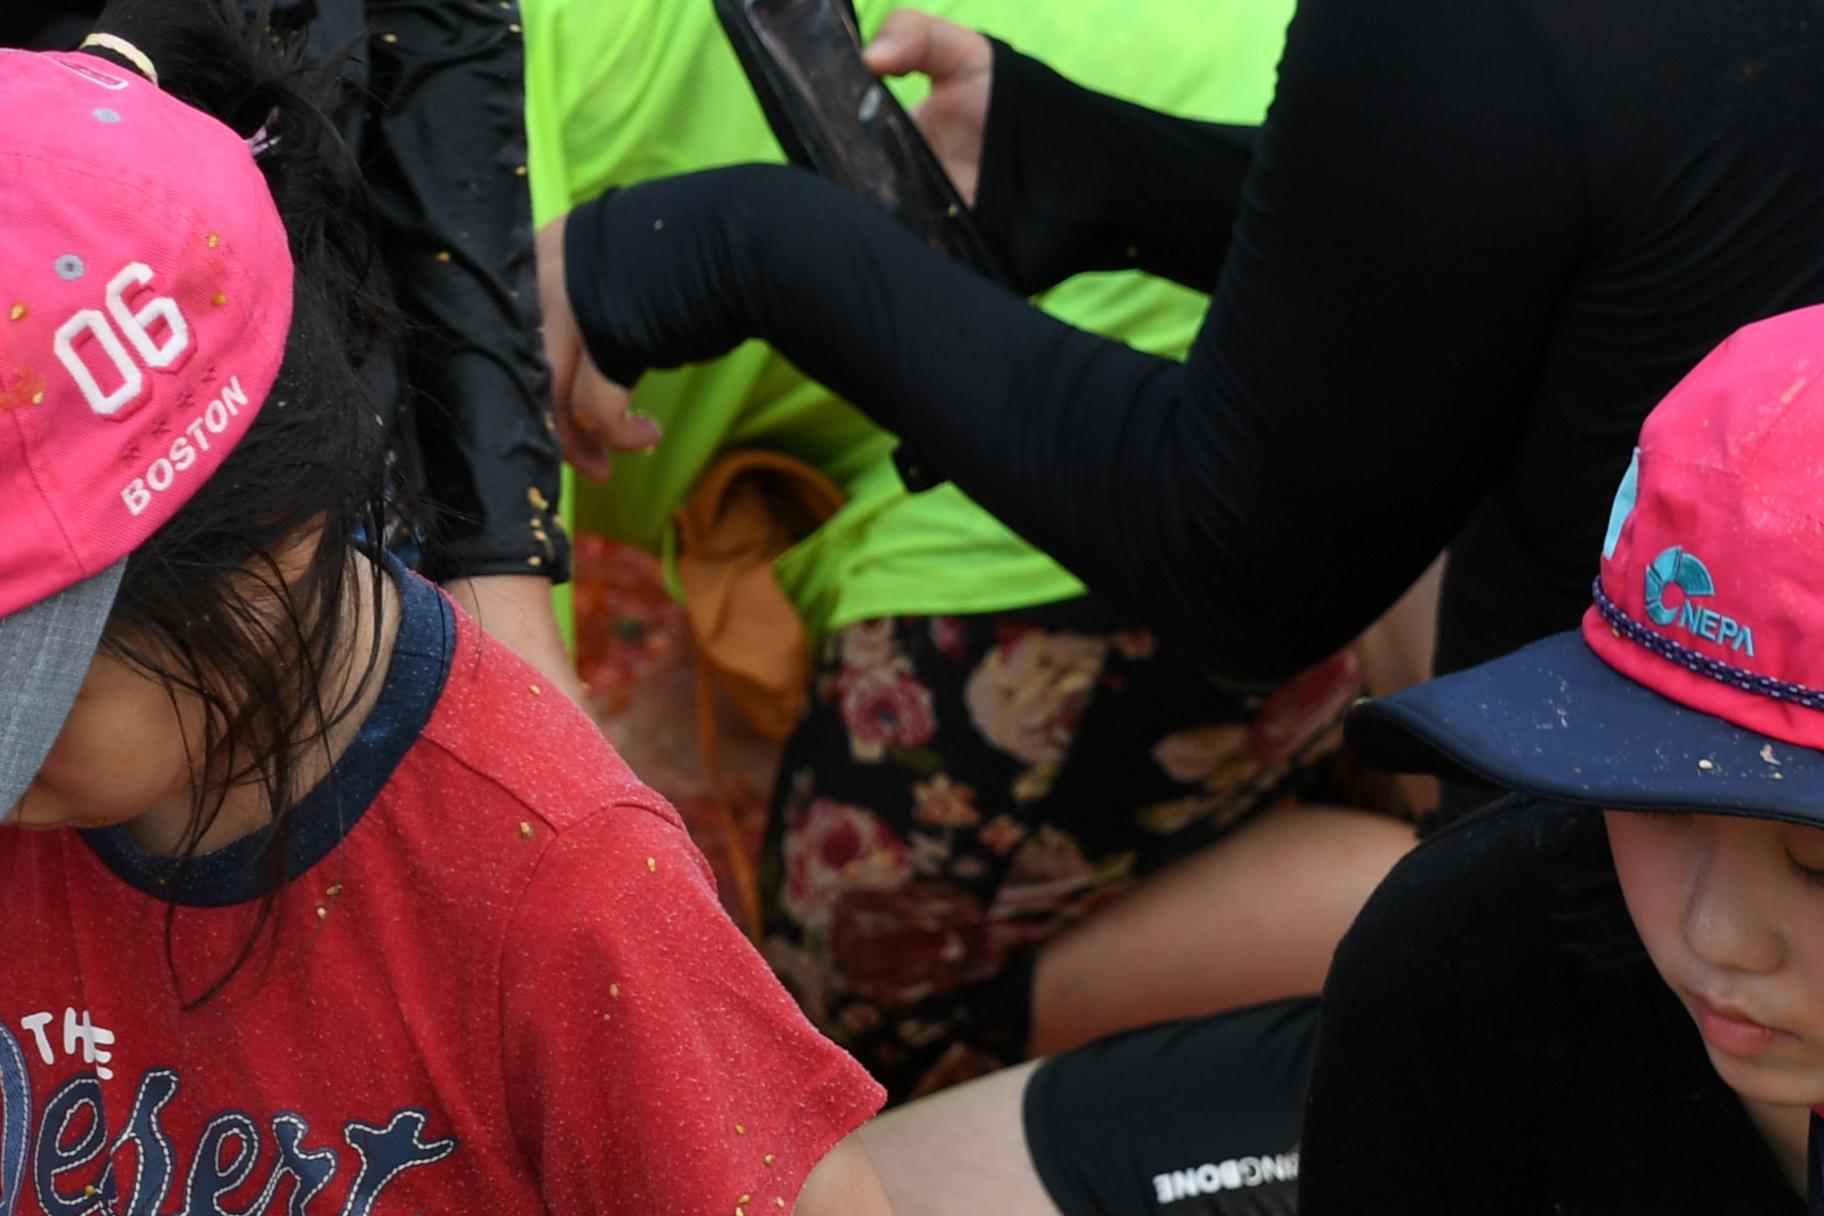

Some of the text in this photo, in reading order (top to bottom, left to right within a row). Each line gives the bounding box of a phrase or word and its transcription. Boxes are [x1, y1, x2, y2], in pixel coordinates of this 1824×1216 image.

[53, 261, 190, 416] 06
[120, 375, 249, 516] BOSTON
[1678, 599, 1755, 657] NEPA
[21, 1006, 115, 1080] THE
